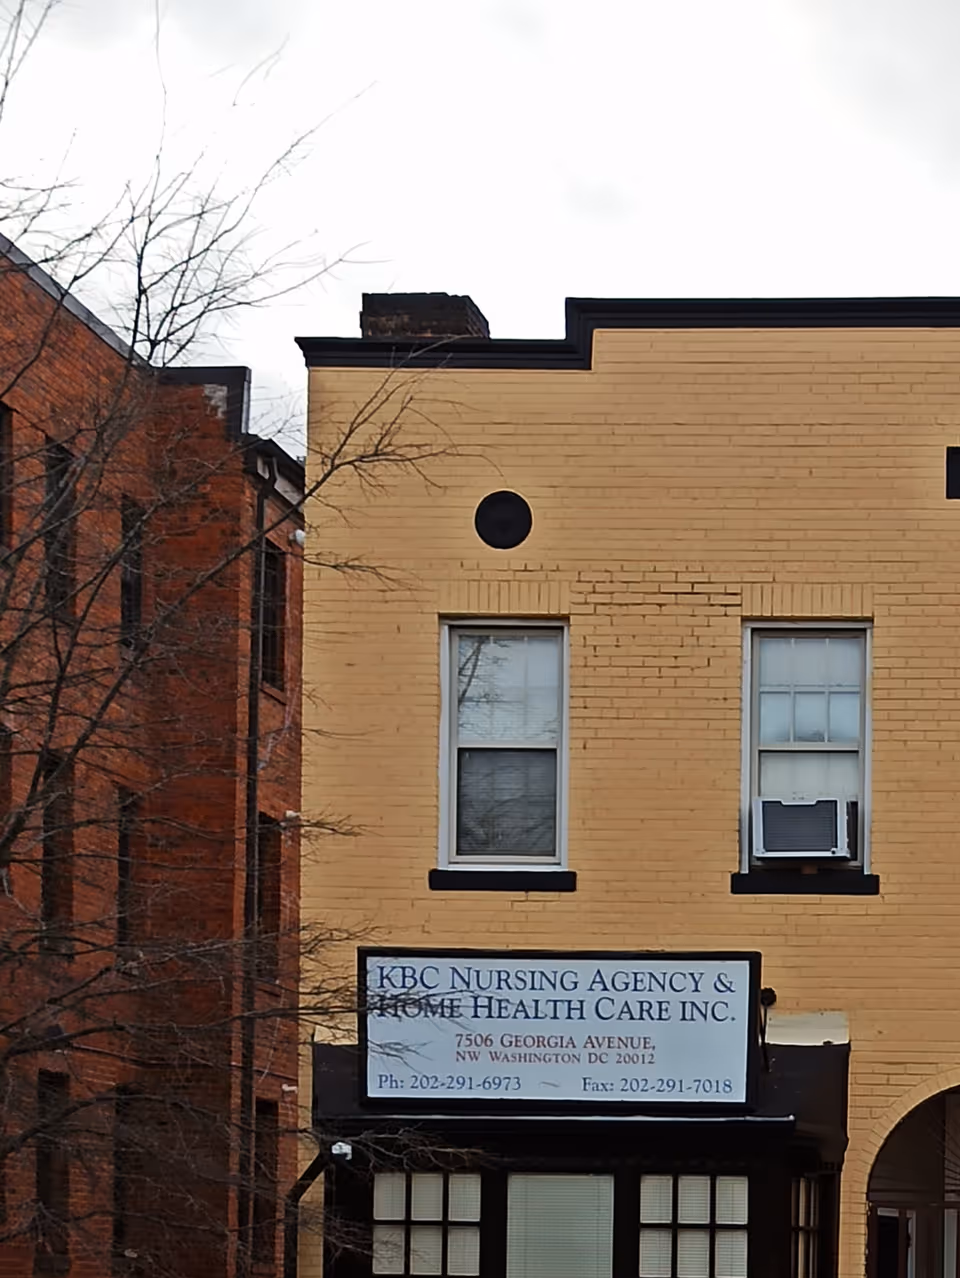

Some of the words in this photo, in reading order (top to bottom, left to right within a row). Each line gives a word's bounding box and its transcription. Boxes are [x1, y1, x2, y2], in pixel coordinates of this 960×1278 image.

[377, 965, 440, 990] KBC
[449, 966, 580, 992] NURSING
[587, 968, 705, 993] AGENCY
[713, 972, 736, 993] &
[377, 994, 463, 1018] HOME
[471, 995, 586, 1020] HEALTH
[595, 996, 672, 1021] CARE
[680, 1000, 737, 1022] INC.
[455, 1033, 494, 1048] 7506
[500, 1033, 577, 1049] GEORGIA
[583, 1035, 656, 1051] AVENUE,
[455, 1050, 481, 1063] NW
[489, 1051, 581, 1064] WASHINGTON
[588, 1052, 609, 1065] DC
[615, 1053, 656, 1065] 20012
[377, 1073, 404, 1089] Ph:
[409, 1074, 522, 1091] 202-291-6973
[581, 1076, 615, 1092] Fax:
[619, 1077, 734, 1094] 202-291-7018
